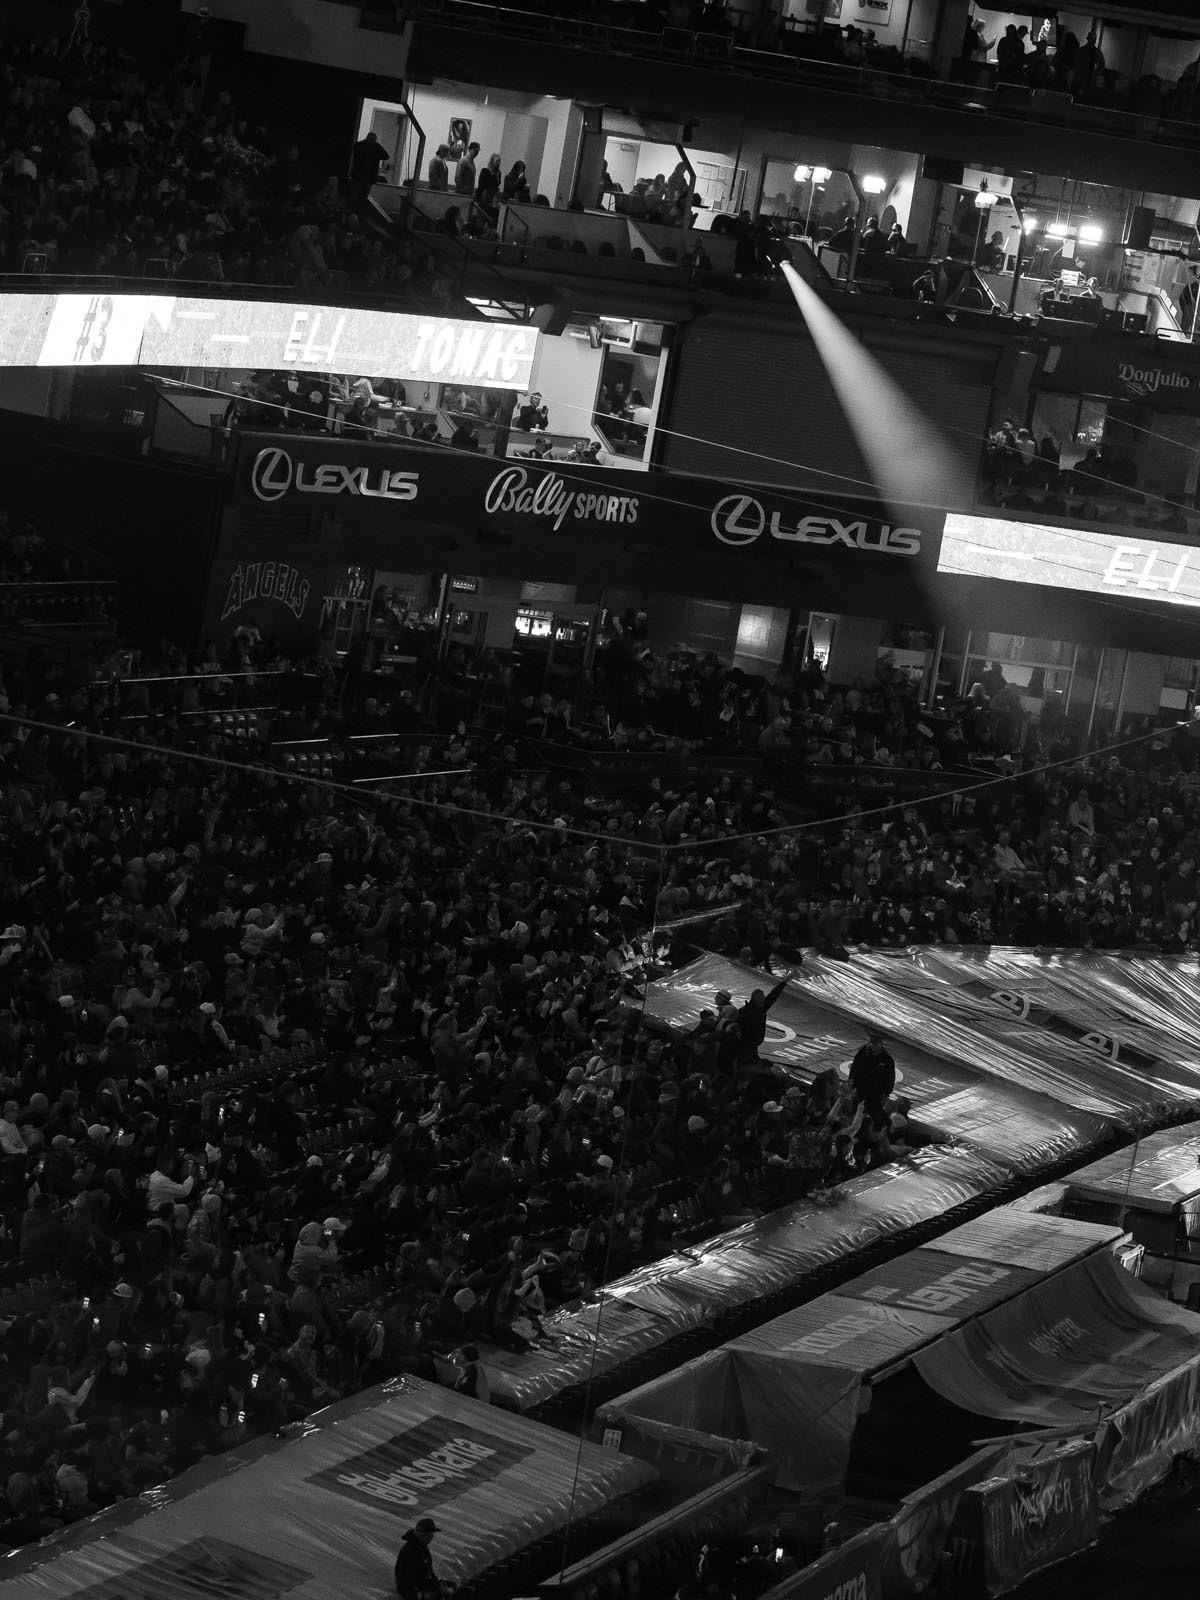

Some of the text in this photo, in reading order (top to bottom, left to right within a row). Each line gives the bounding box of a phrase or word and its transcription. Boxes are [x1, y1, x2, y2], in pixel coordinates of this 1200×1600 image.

[283, 310, 346, 364] ELI
[408, 323, 527, 381] TOMAC
[296, 461, 420, 501] LEXUS
[485, 466, 640, 531] Bally SPORTS
[770, 511, 922, 556] LEXUS
[221, 561, 311, 620] ANGELS
[1102, 544, 1190, 592] ELI
[363, 1437, 497, 1498] Husqvarna
